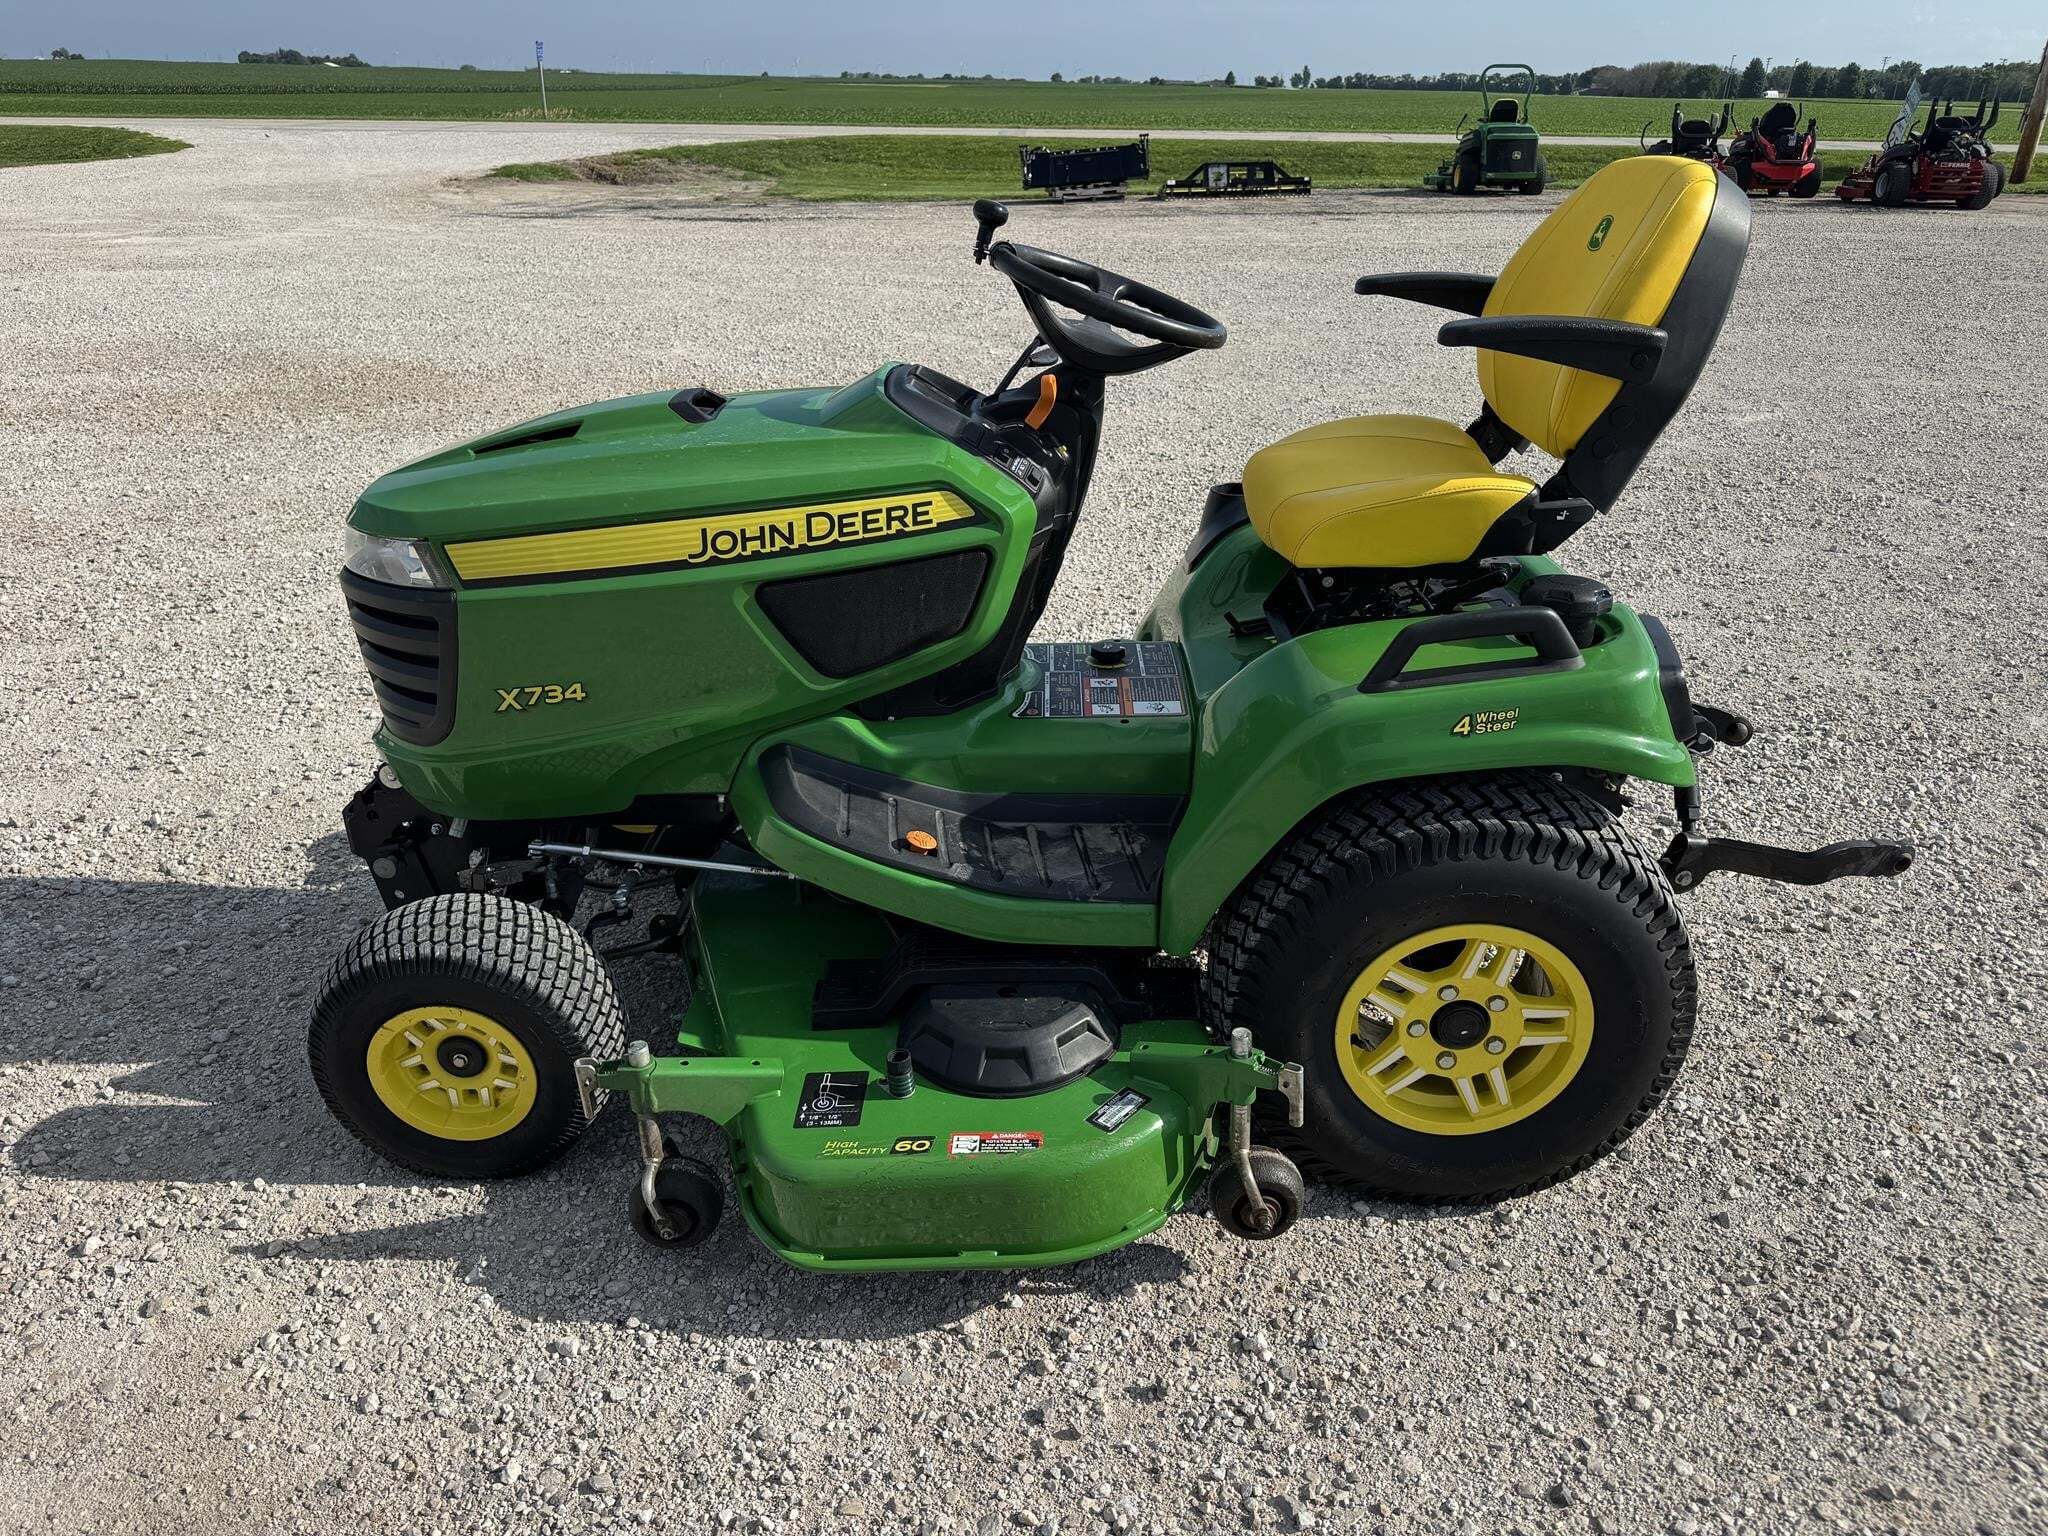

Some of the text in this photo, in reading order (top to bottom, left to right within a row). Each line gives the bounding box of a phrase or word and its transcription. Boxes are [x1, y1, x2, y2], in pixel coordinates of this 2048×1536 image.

[687, 501, 934, 560] JOHN DEERE
[496, 682, 586, 712] X734
[1453, 707, 1519, 735] 4 Wheel
[1475, 720, 1517, 734] Steer
[822, 1147, 888, 1156] CAPACITY
[825, 1140, 931, 1152] HIGH 60
